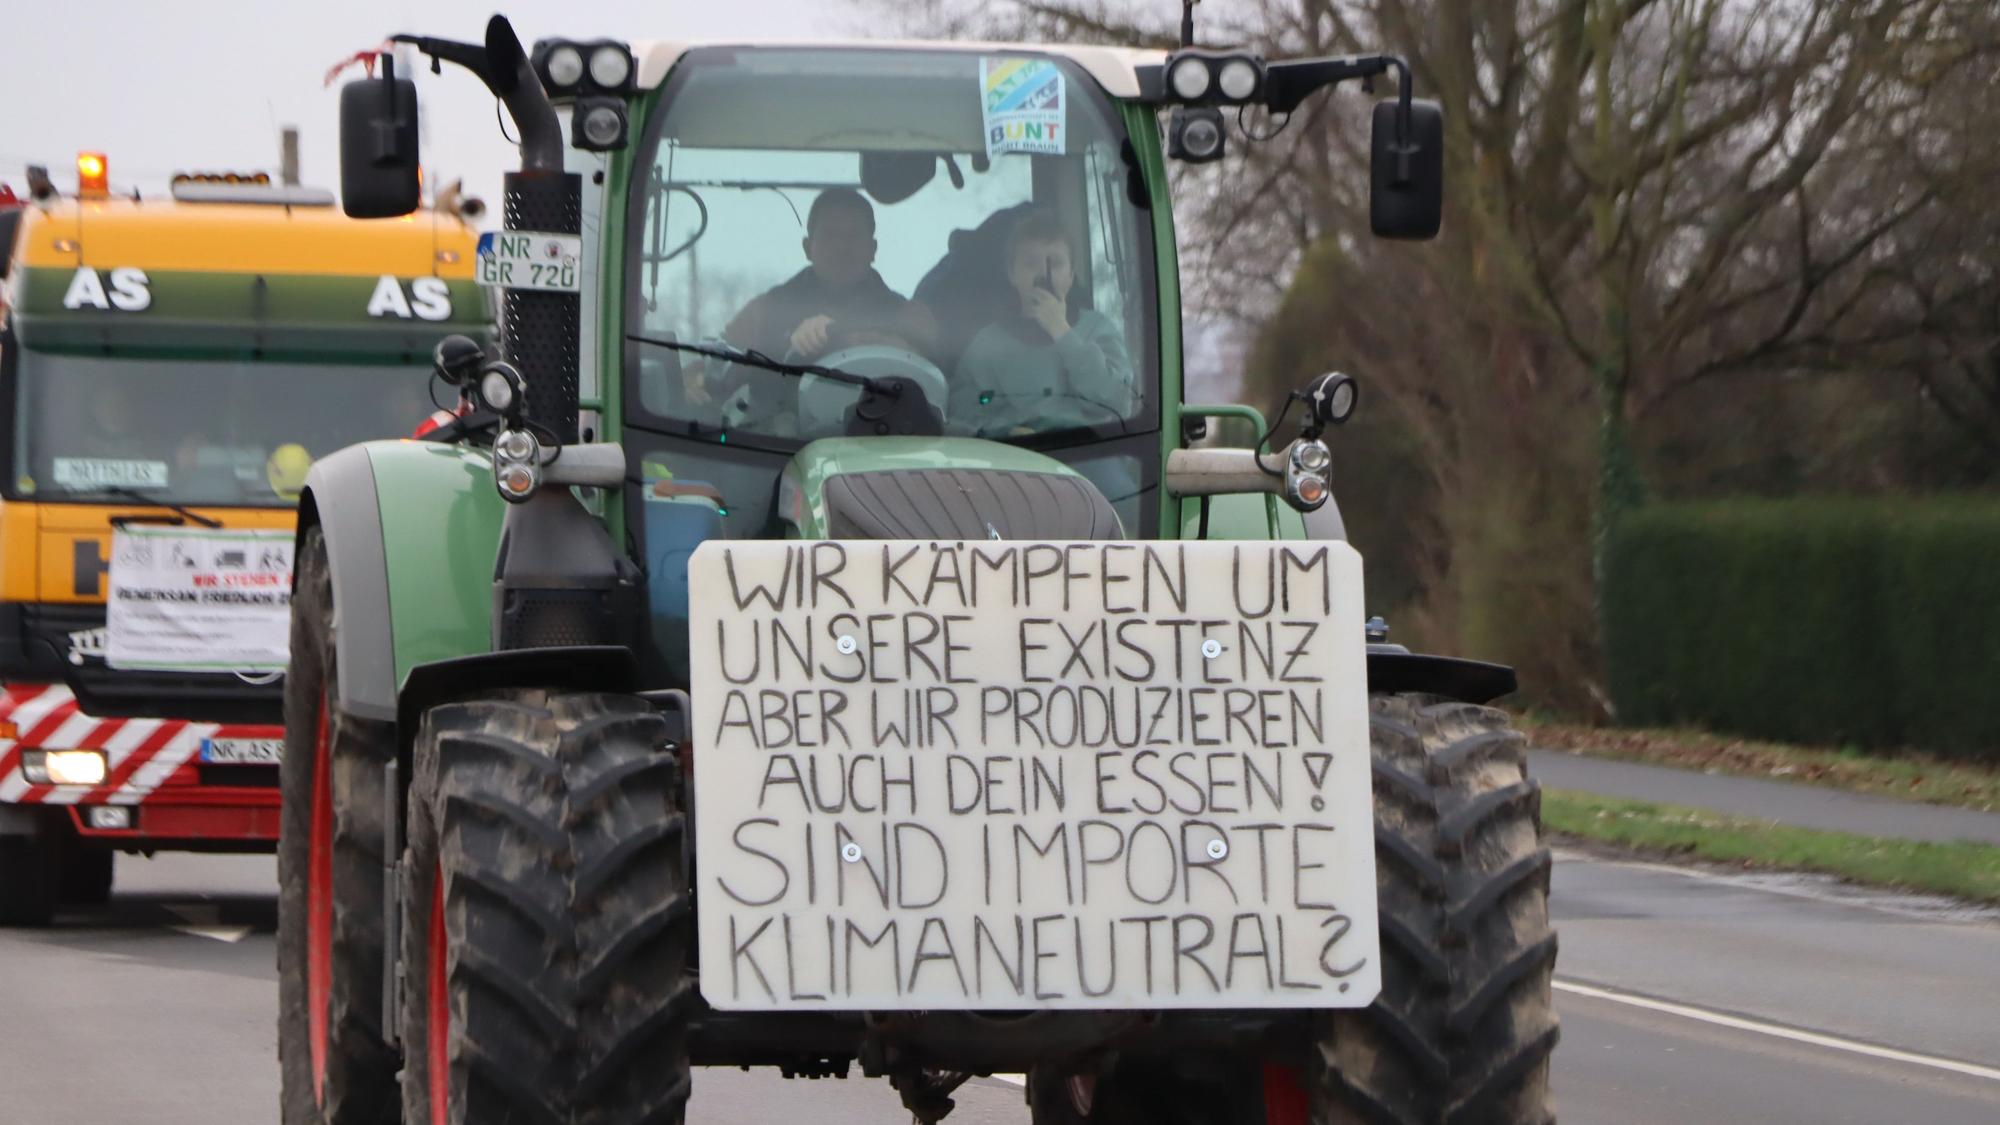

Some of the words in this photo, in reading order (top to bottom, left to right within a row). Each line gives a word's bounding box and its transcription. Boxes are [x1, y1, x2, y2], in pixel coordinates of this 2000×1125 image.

[990, 122, 1060, 144] BUNT
[483, 261, 513, 284] GR
[530, 263, 574, 287] 720
[500, 235, 530, 259] NR
[63, 266, 151, 311] AS
[367, 274, 452, 321] AS
[724, 541, 855, 612] WIR
[881, 541, 1187, 613] KÄMPFEN
[1232, 545, 1330, 619] UM
[717, 611, 978, 684] UNSERE
[1019, 618, 1324, 684] EXISTENZ
[715, 688, 852, 750] ABER
[871, 686, 959, 750] WIR
[980, 685, 1325, 750] PRODUZIEREN
[212, 741, 237, 760] NR
[248, 741, 272, 760] AS
[757, 753, 918, 816] AUCH
[946, 753, 1066, 816] DEIN
[716, 817, 949, 912] SIND
[983, 819, 1337, 912] IMPORTE
[729, 913, 1367, 1003] KLIMANEUTRAL?
